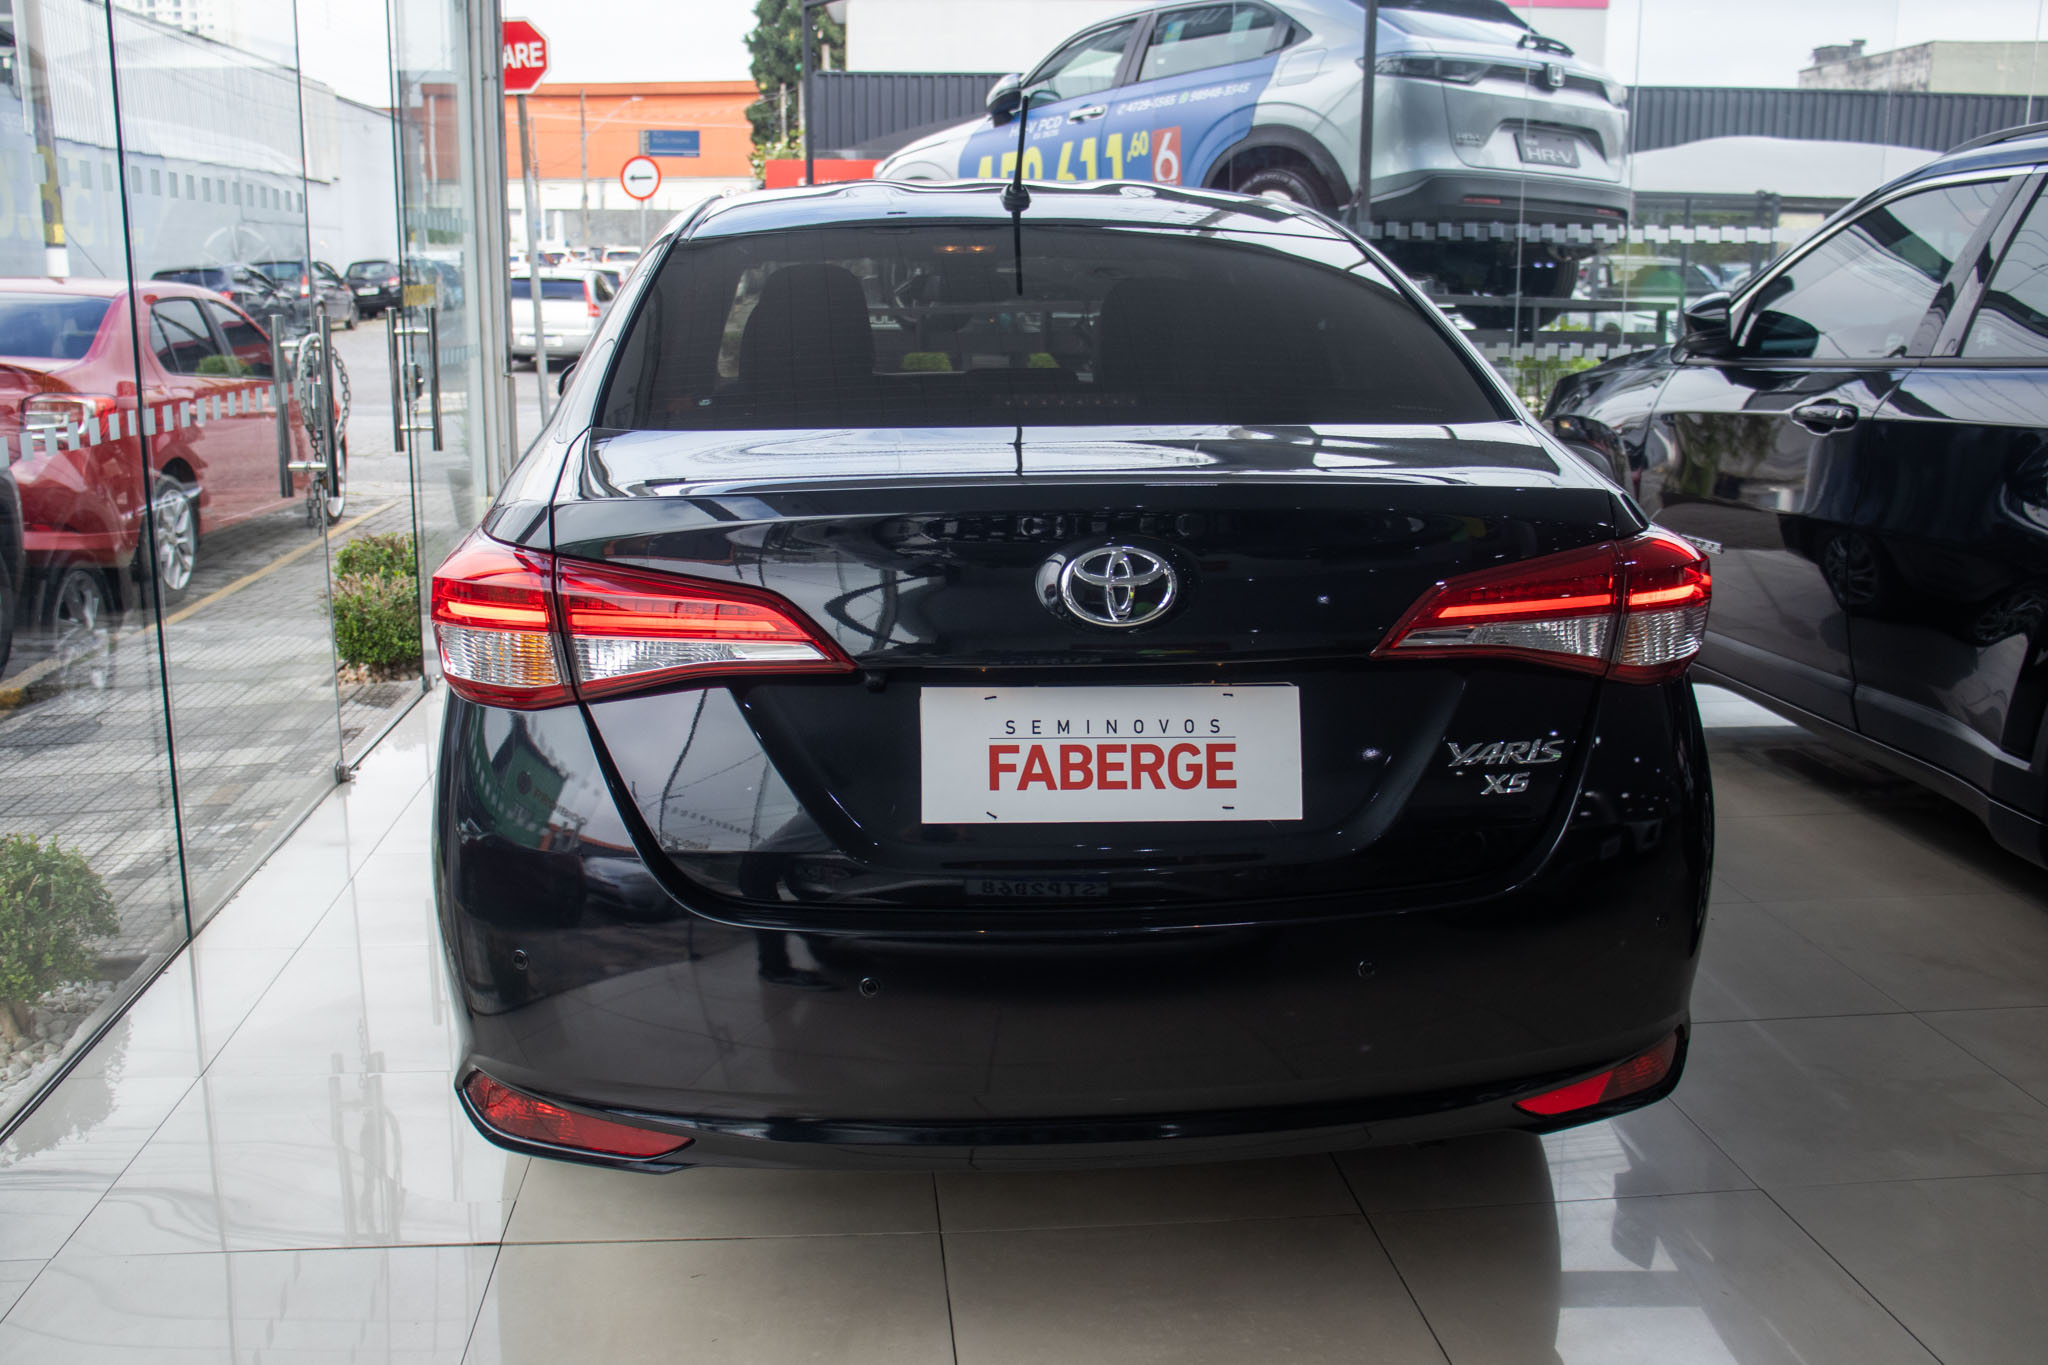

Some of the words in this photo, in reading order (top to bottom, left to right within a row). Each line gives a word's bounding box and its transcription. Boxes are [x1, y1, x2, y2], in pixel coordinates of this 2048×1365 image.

[503, 42, 544, 69] ARE
[1009, 121, 1039, 138] H-V
[1154, 132, 1179, 182] 6
[1526, 147, 1573, 163] HR-V
[1005, 719, 1221, 735] SEMINOVOS
[1447, 738, 1565, 767] YARIS
[989, 742, 1238, 791] FABERGE
[1480, 771, 1531, 795] XS
